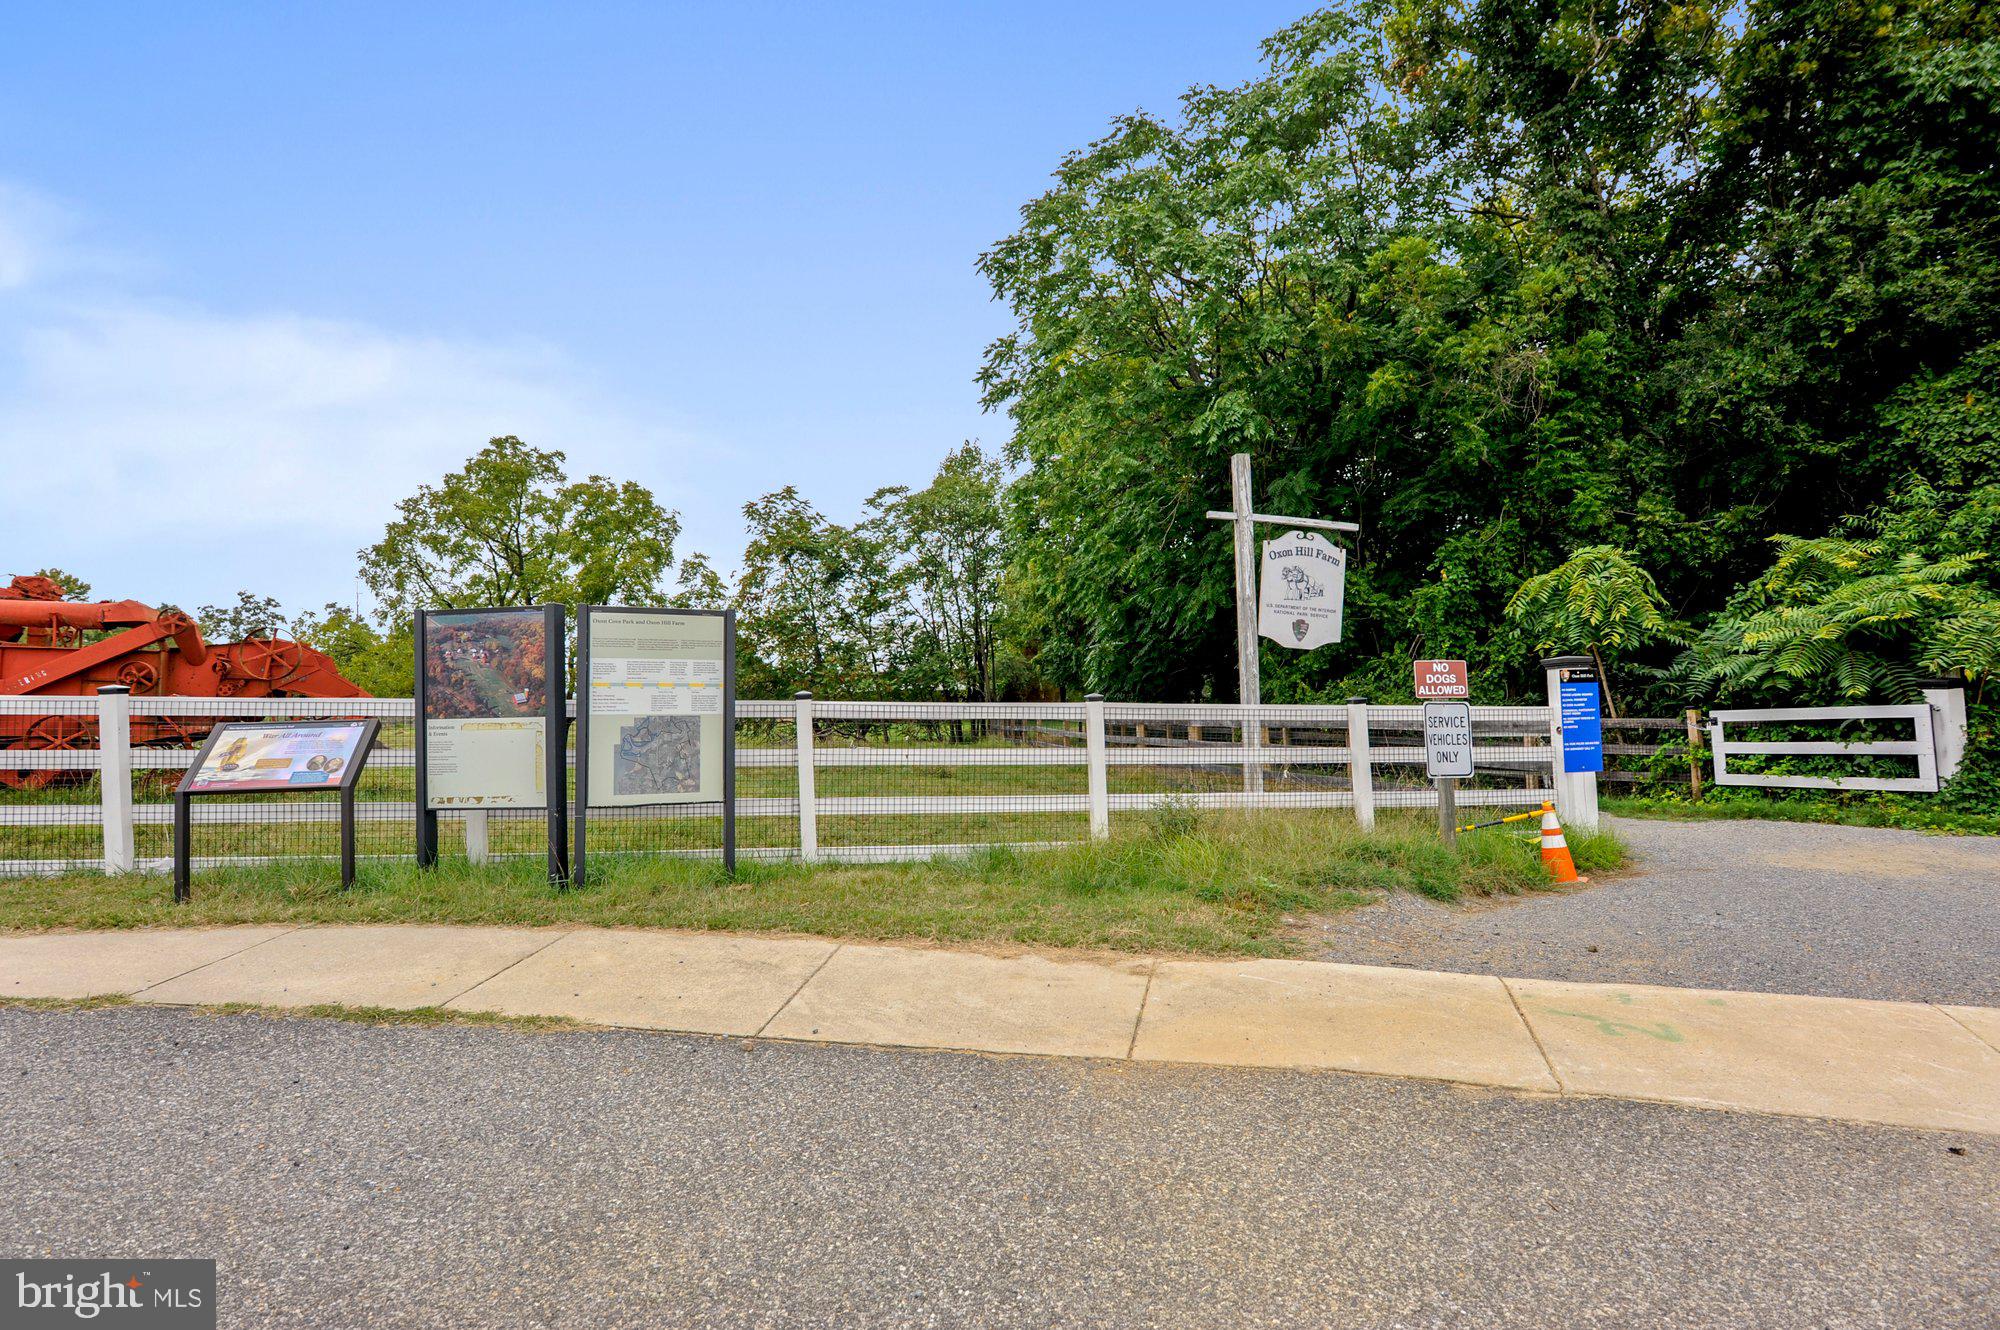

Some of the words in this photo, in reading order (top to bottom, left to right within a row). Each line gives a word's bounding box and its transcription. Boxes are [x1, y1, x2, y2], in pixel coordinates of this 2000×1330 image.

[1269, 549, 1293, 560] Oxon
[1295, 546, 1313, 557] Hill
[1316, 548, 1340, 566] Farm
[1432, 663, 1449, 673] NO
[1426, 674, 1457, 684] DOGS
[1418, 685, 1466, 695] ALLOWED
[1428, 716, 1466, 728] SERVICE
[1428, 734, 1468, 746] VEHICLES
[1436, 751, 1459, 763] ONLY
